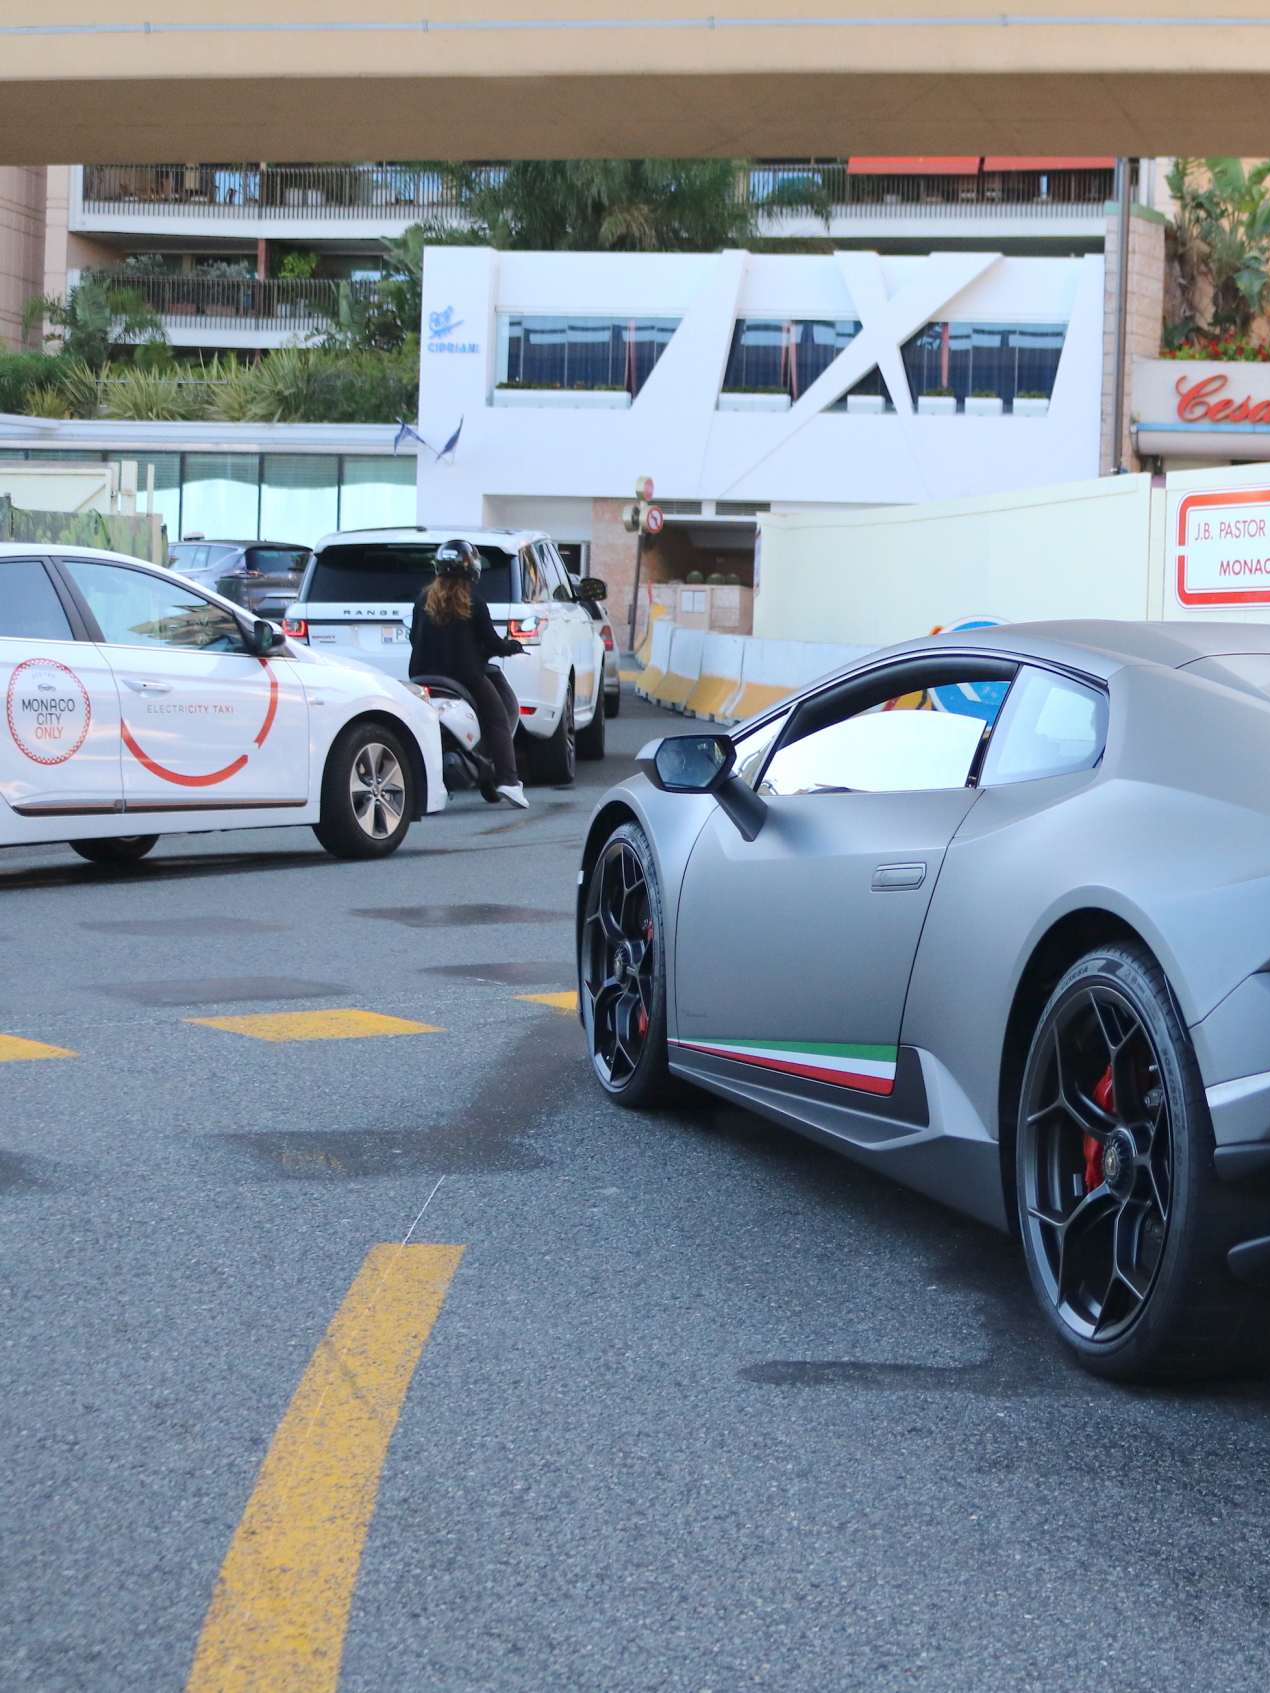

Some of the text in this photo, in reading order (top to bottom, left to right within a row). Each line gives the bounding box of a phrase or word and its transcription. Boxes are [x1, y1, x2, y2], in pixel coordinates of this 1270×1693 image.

[427, 342, 480, 354] CIPRIANI
[1194, 522, 1214, 541] J.B.
[1219, 519, 1266, 539] PASTOR
[21, 698, 76, 713] MONACO
[147, 704, 234, 715] ELECTRICITY TAXI
[36, 712, 63, 726] CITY
[35, 726, 64, 740] ONLY
